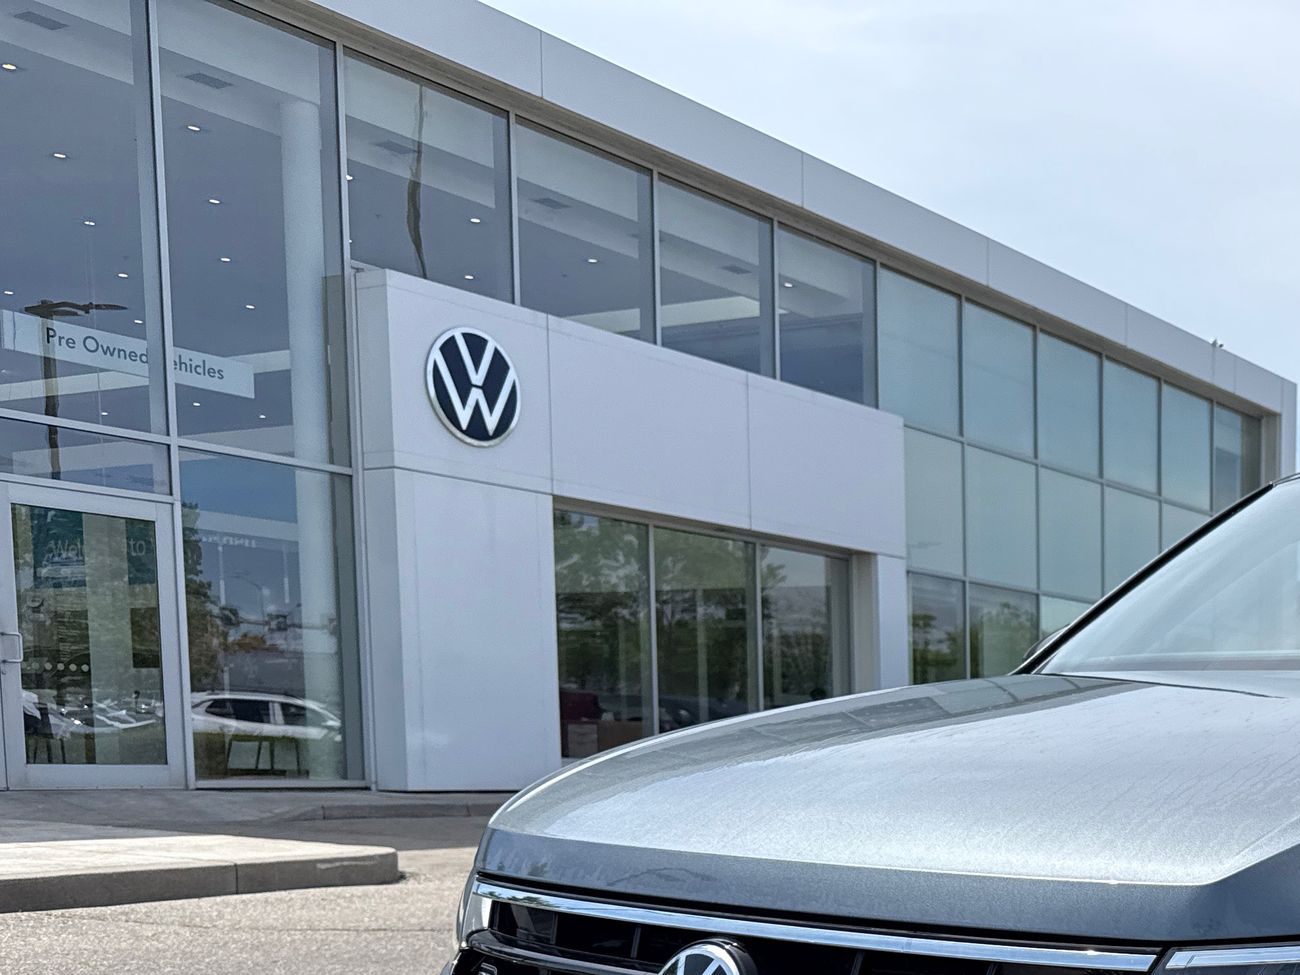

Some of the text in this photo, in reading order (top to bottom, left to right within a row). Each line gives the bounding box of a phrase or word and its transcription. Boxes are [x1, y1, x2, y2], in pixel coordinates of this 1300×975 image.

[46, 326, 225, 380] Pre Owned ehicles
[430, 330, 517, 440] VW
